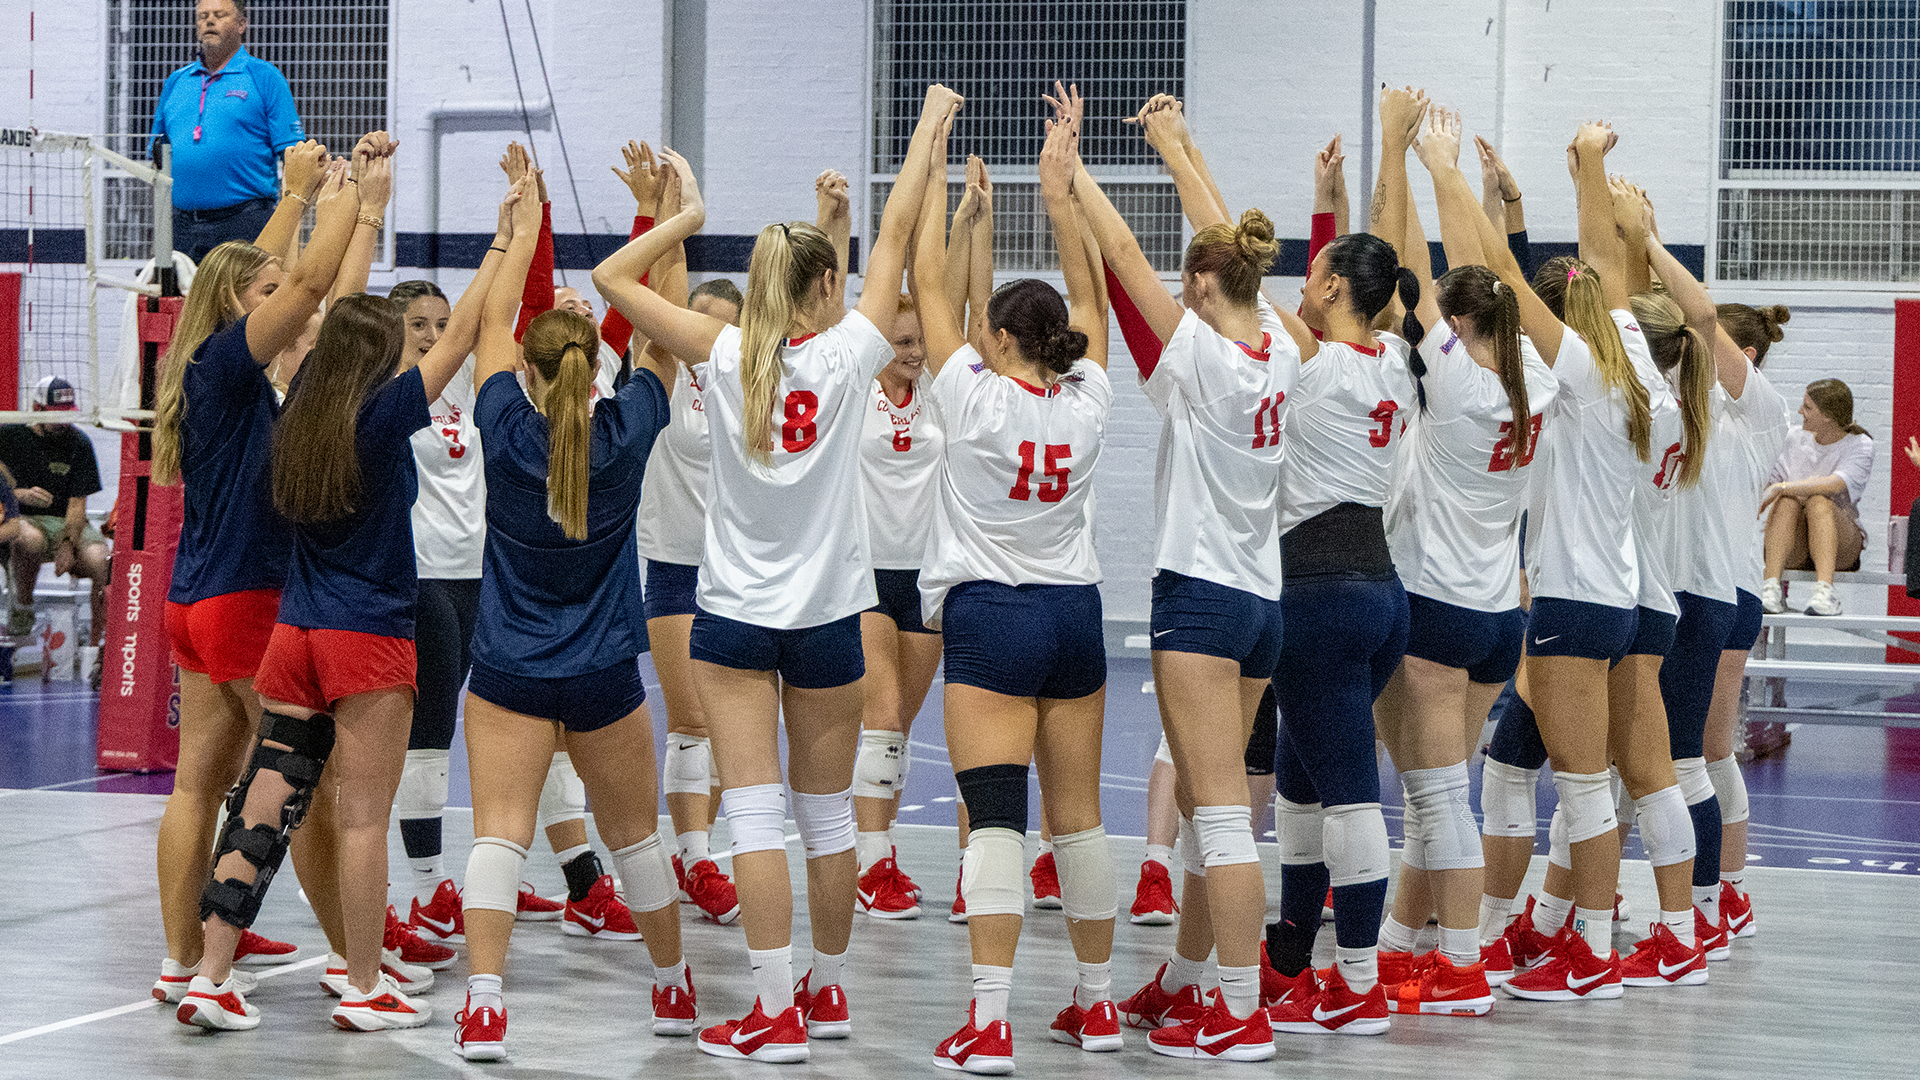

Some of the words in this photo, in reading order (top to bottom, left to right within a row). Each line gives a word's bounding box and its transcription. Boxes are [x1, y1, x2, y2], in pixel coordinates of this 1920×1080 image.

[442, 428, 466, 458] 3
[892, 427, 912, 452] 6
[1252, 391, 1285, 449] 11
[1008, 440, 1072, 502] 15
[127, 563, 143, 623] sports
